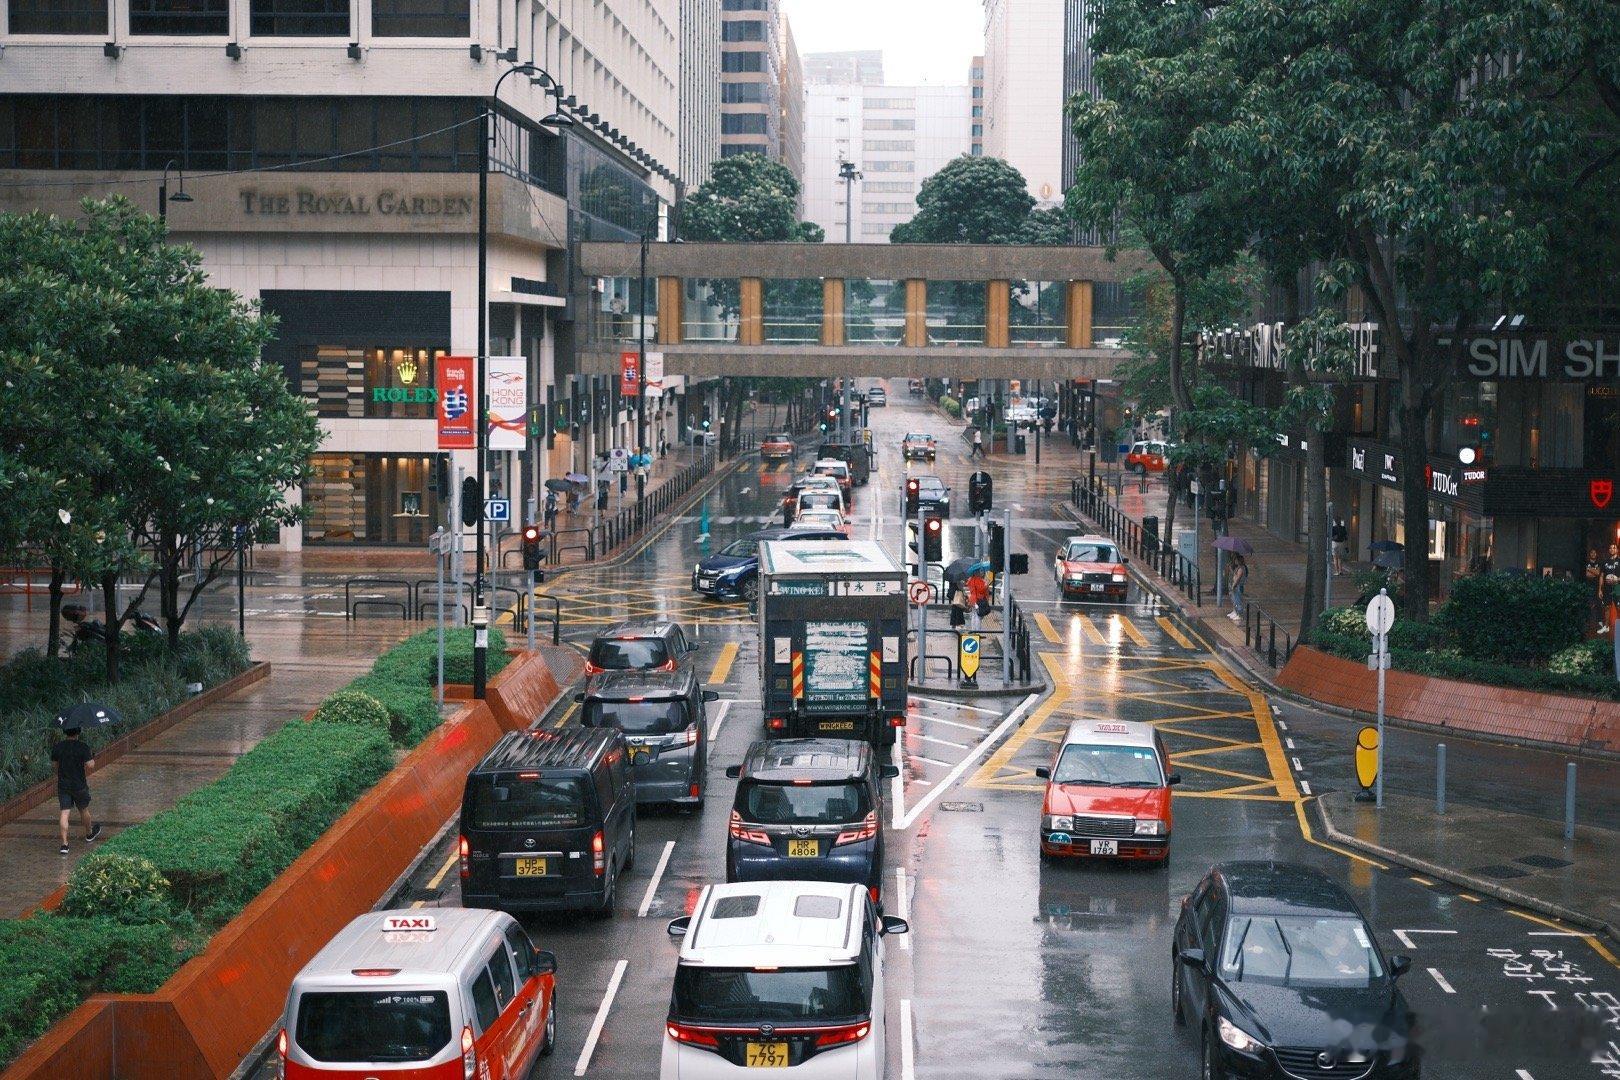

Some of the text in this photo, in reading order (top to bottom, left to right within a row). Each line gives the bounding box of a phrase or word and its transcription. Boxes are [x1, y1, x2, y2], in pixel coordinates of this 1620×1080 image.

[239, 187, 473, 215] THE ROYAL GARDEN
[373, 387, 438, 403] ROLEX
[491, 388, 524, 397] HONG
[491, 397, 524, 405] KONG
[1464, 470, 1485, 481] TUDOR
[493, 503, 505, 517] P
[1097, 723, 1127, 732] TAXI
[796, 840, 809, 849] HR
[791, 848, 816, 856] 4808
[524, 859, 537, 867] HP
[518, 866, 544, 875] 3725
[389, 919, 429, 928] TAXI
[758, 1044, 776, 1054] ZC
[749, 1054, 785, 1067] 7797
